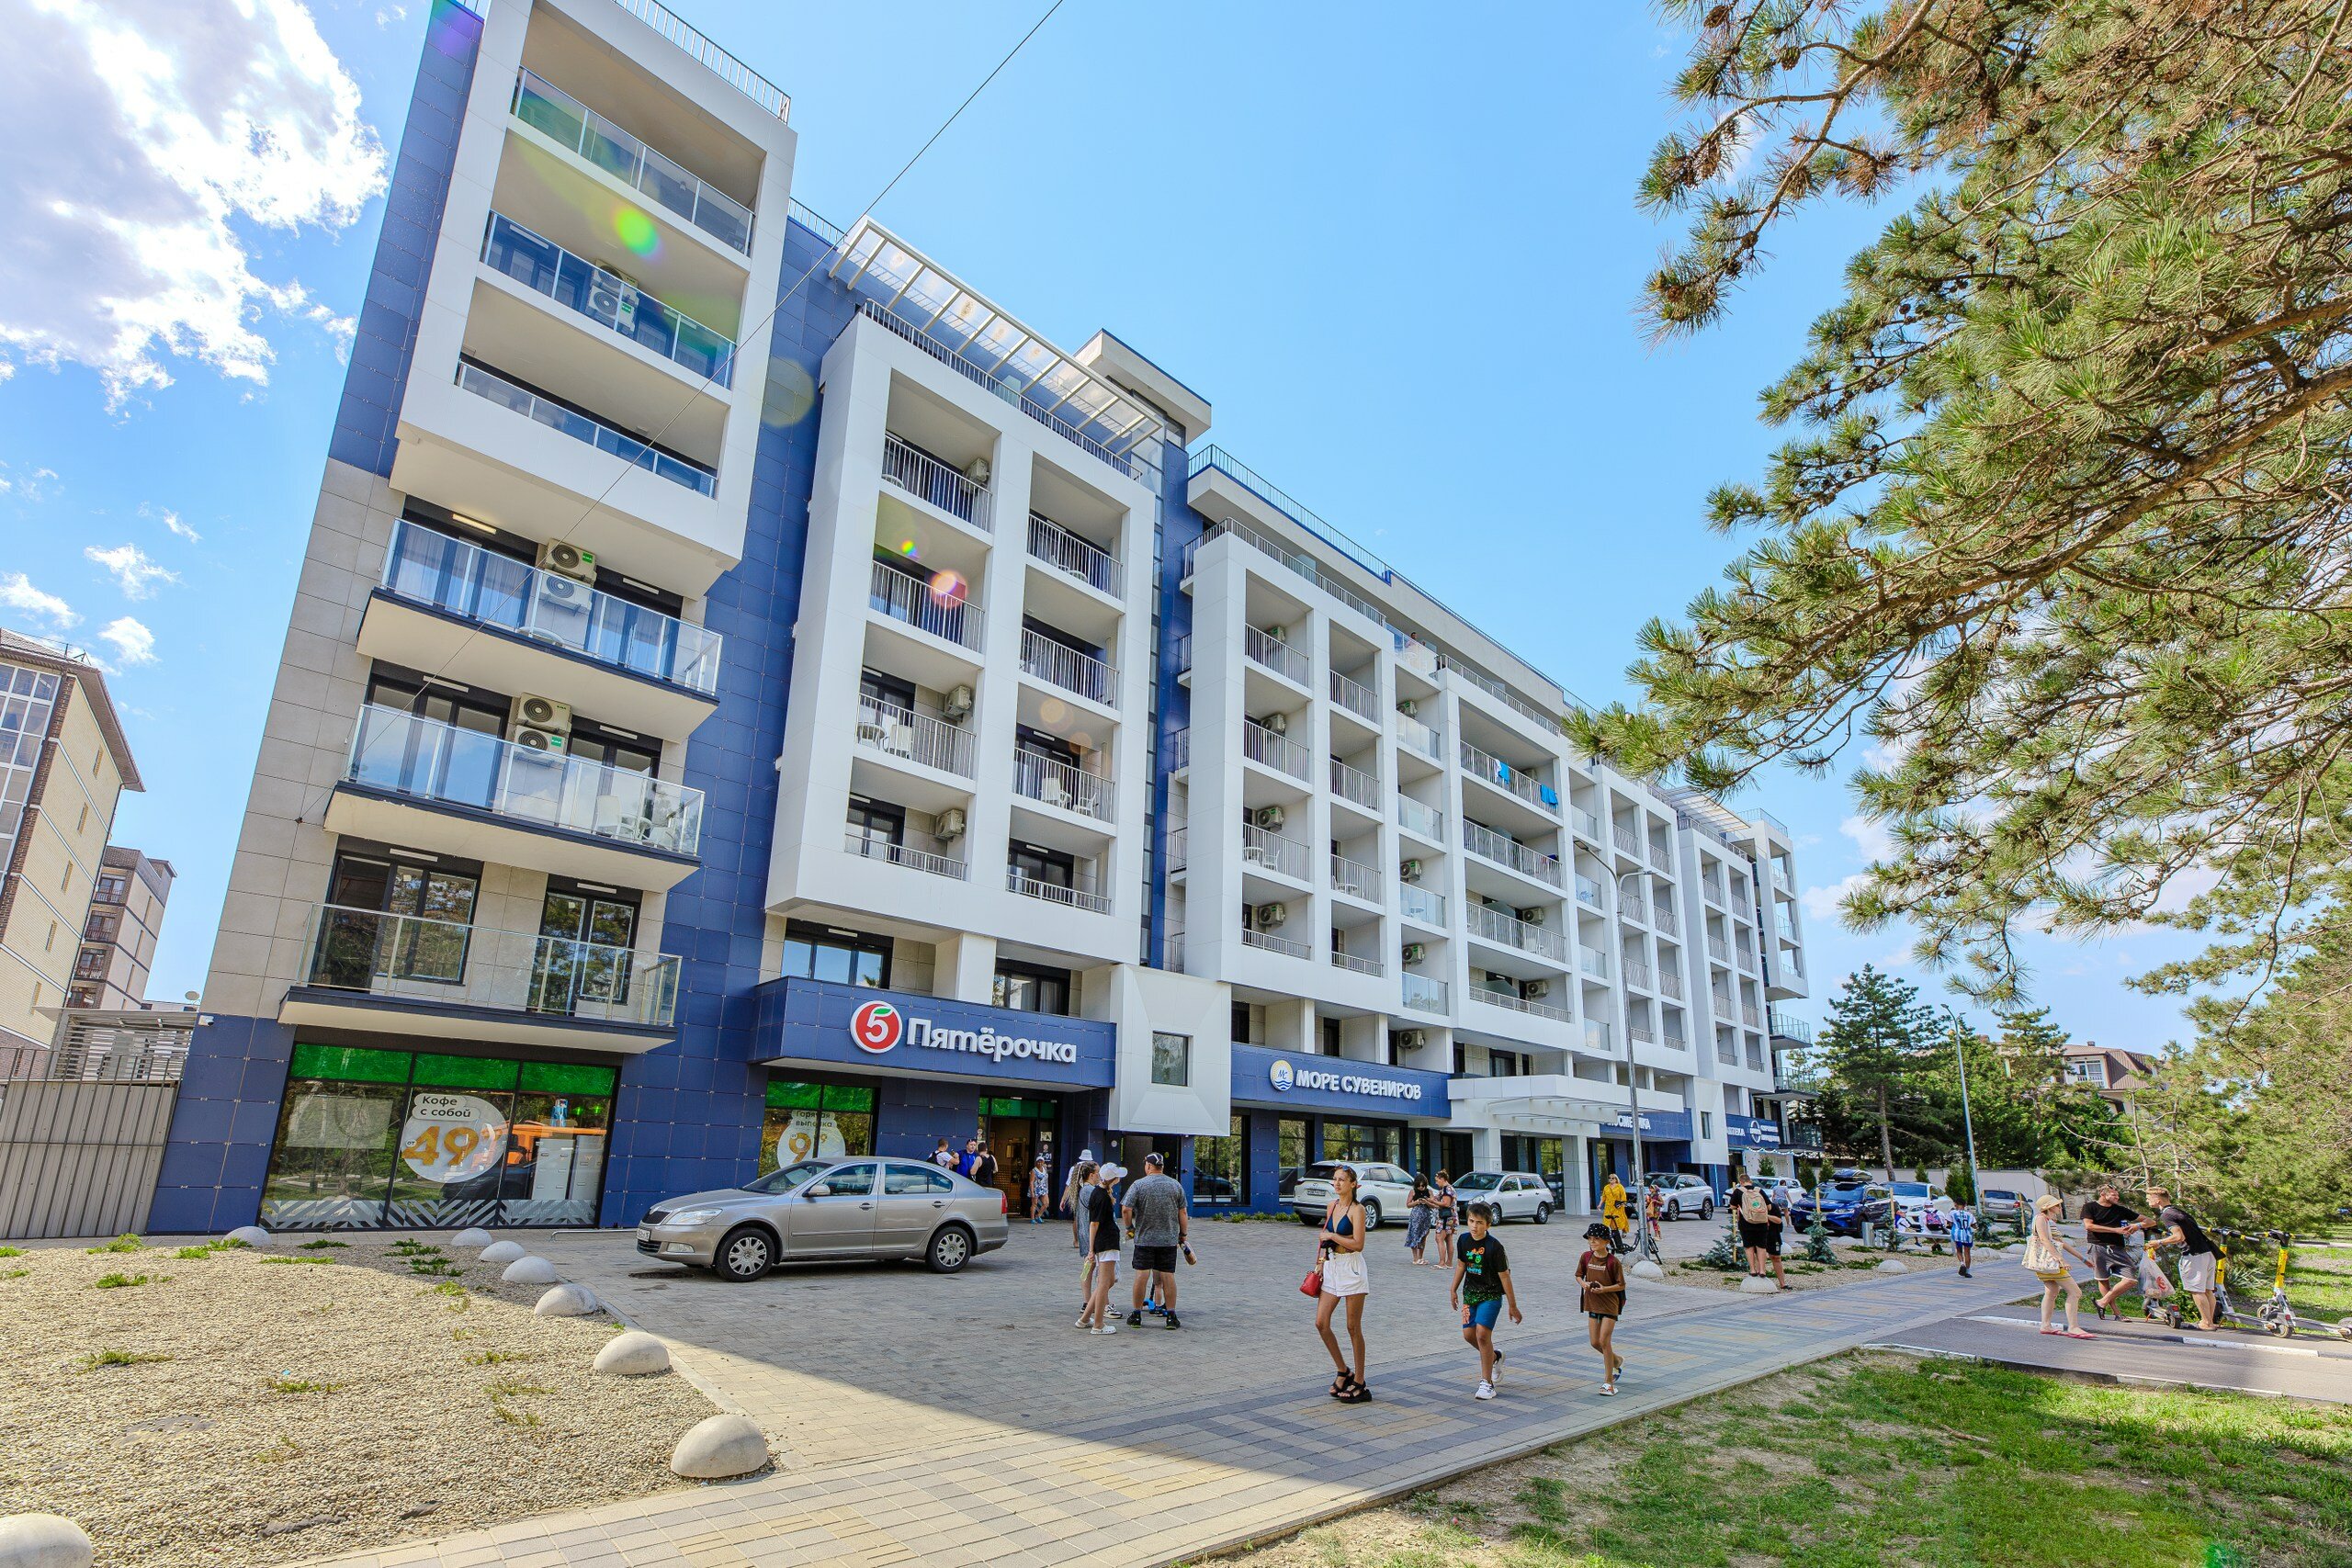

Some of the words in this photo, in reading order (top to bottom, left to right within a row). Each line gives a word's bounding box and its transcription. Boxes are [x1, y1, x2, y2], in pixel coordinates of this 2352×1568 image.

[907, 1017, 1077, 1063] Пятёрочка
[1295, 1070, 1340, 1091] МОРЕ
[1340, 1076, 1421, 1100] СУВЕНИРОВ
[420, 1108, 427, 1116] с
[431, 1108, 471, 1118] собой
[422, 1096, 458, 1107] Кофе
[401, 1126, 479, 1167] 49
[788, 1132, 812, 1163] 9
